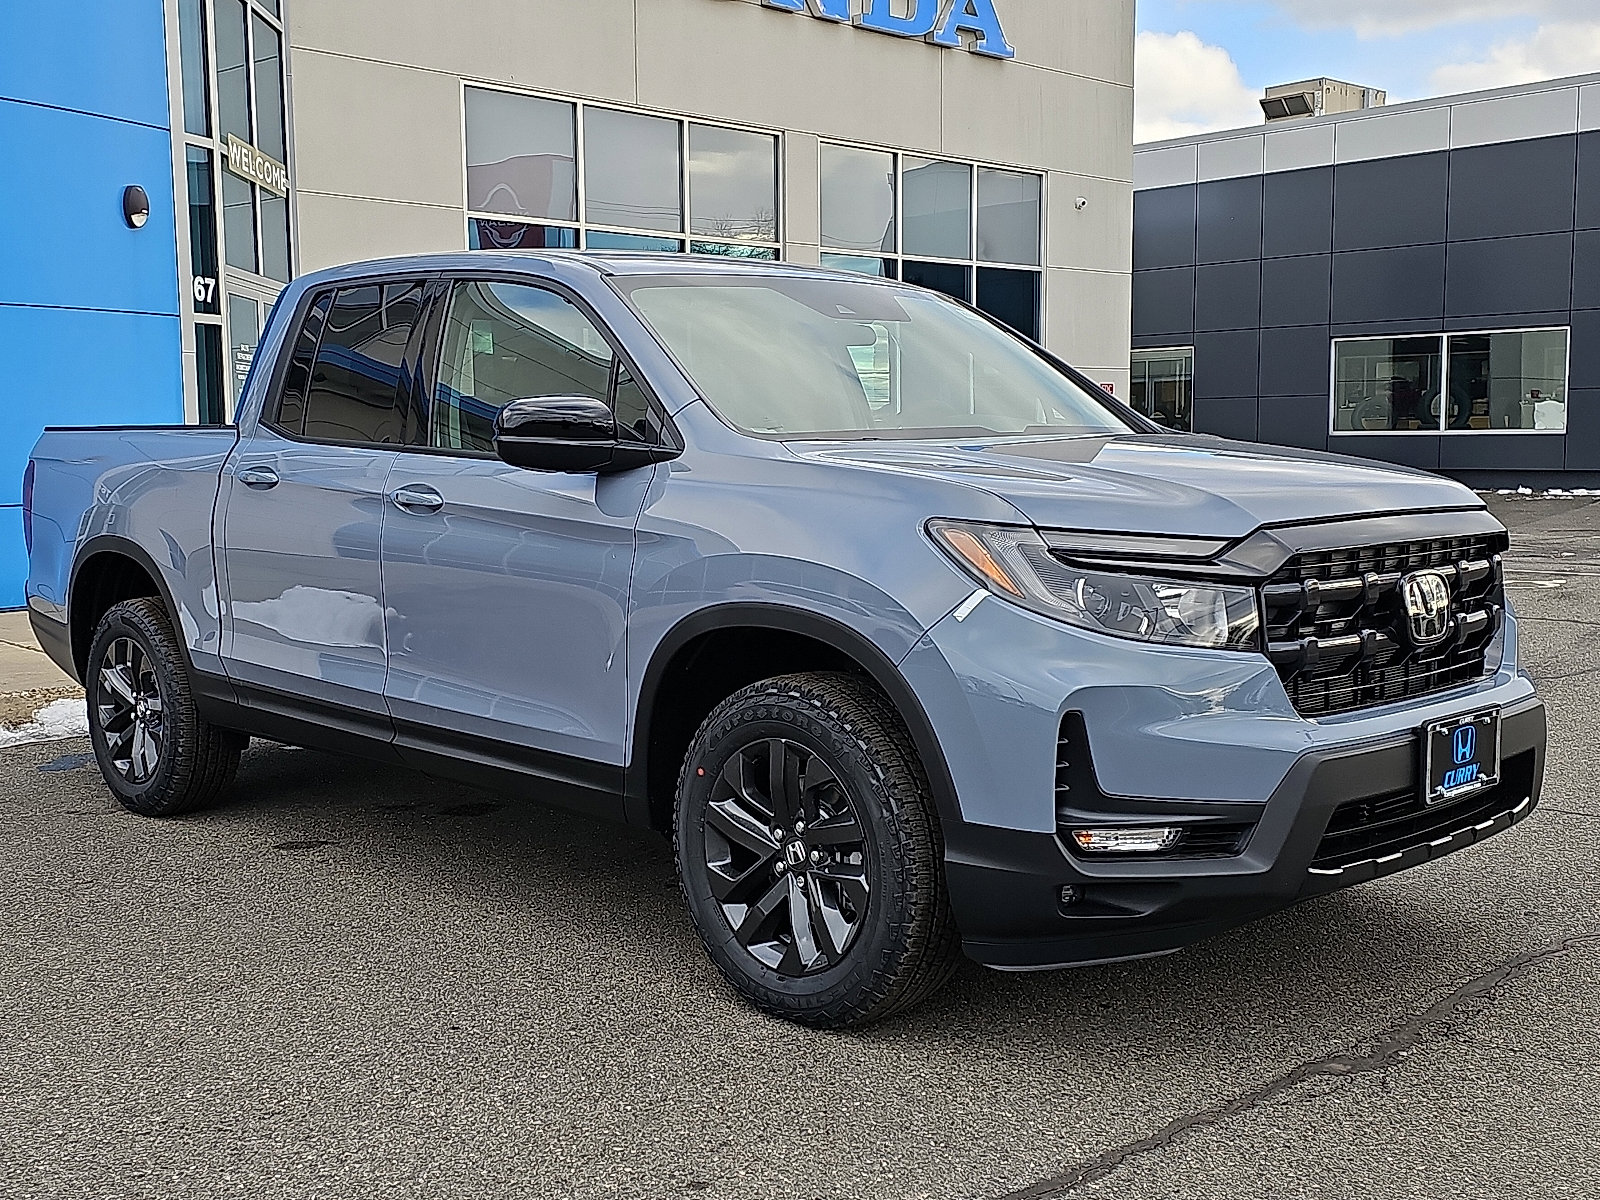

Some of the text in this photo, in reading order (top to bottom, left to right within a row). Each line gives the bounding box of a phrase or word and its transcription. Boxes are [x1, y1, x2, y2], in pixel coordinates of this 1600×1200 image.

[228, 139, 287, 194] WELCOME
[193, 275, 216, 304] 67
[1443, 763, 1481, 789] CURRY
